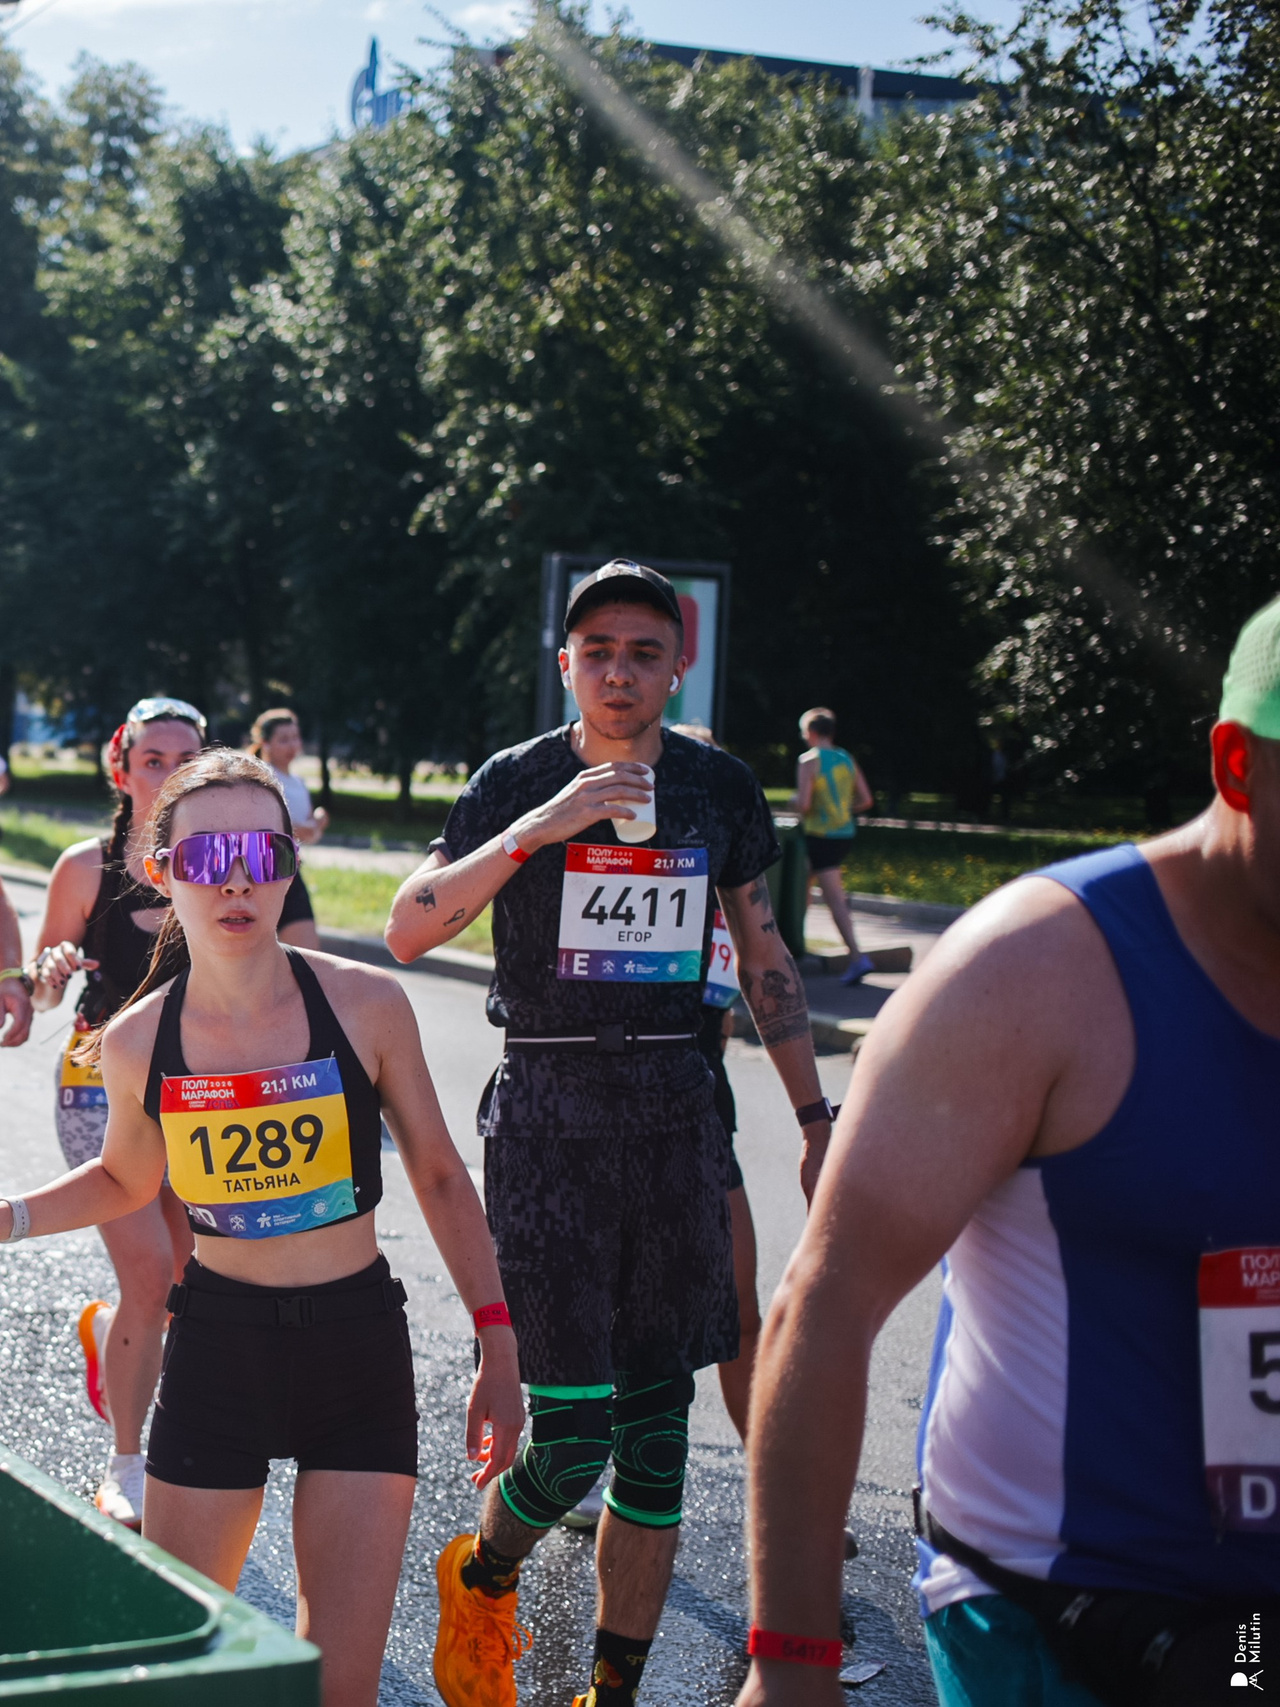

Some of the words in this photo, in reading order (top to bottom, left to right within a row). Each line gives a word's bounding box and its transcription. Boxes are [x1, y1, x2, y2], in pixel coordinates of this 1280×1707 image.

[586, 856, 633, 866] МАРАФОН
[587, 847, 613, 857] ПОЛУ
[653, 858, 674, 869] 21,1
[677, 857, 696, 869] КМ
[581, 885, 687, 928] 4411
[617, 930, 653, 943] ЕГОР
[572, 952, 590, 976] E
[181, 1079, 209, 1090] ПОЛУ
[260, 1077, 288, 1095] 21,1
[291, 1073, 317, 1089] КМ
[63, 1088, 74, 1106] D
[181, 1088, 235, 1101] МАРАФОН
[189, 1113, 324, 1176] 1289
[223, 1172, 301, 1194] ТАТЬЯНА
[1248, 1330, 1280, 1415] 5
[1240, 1474, 1277, 1519] D
